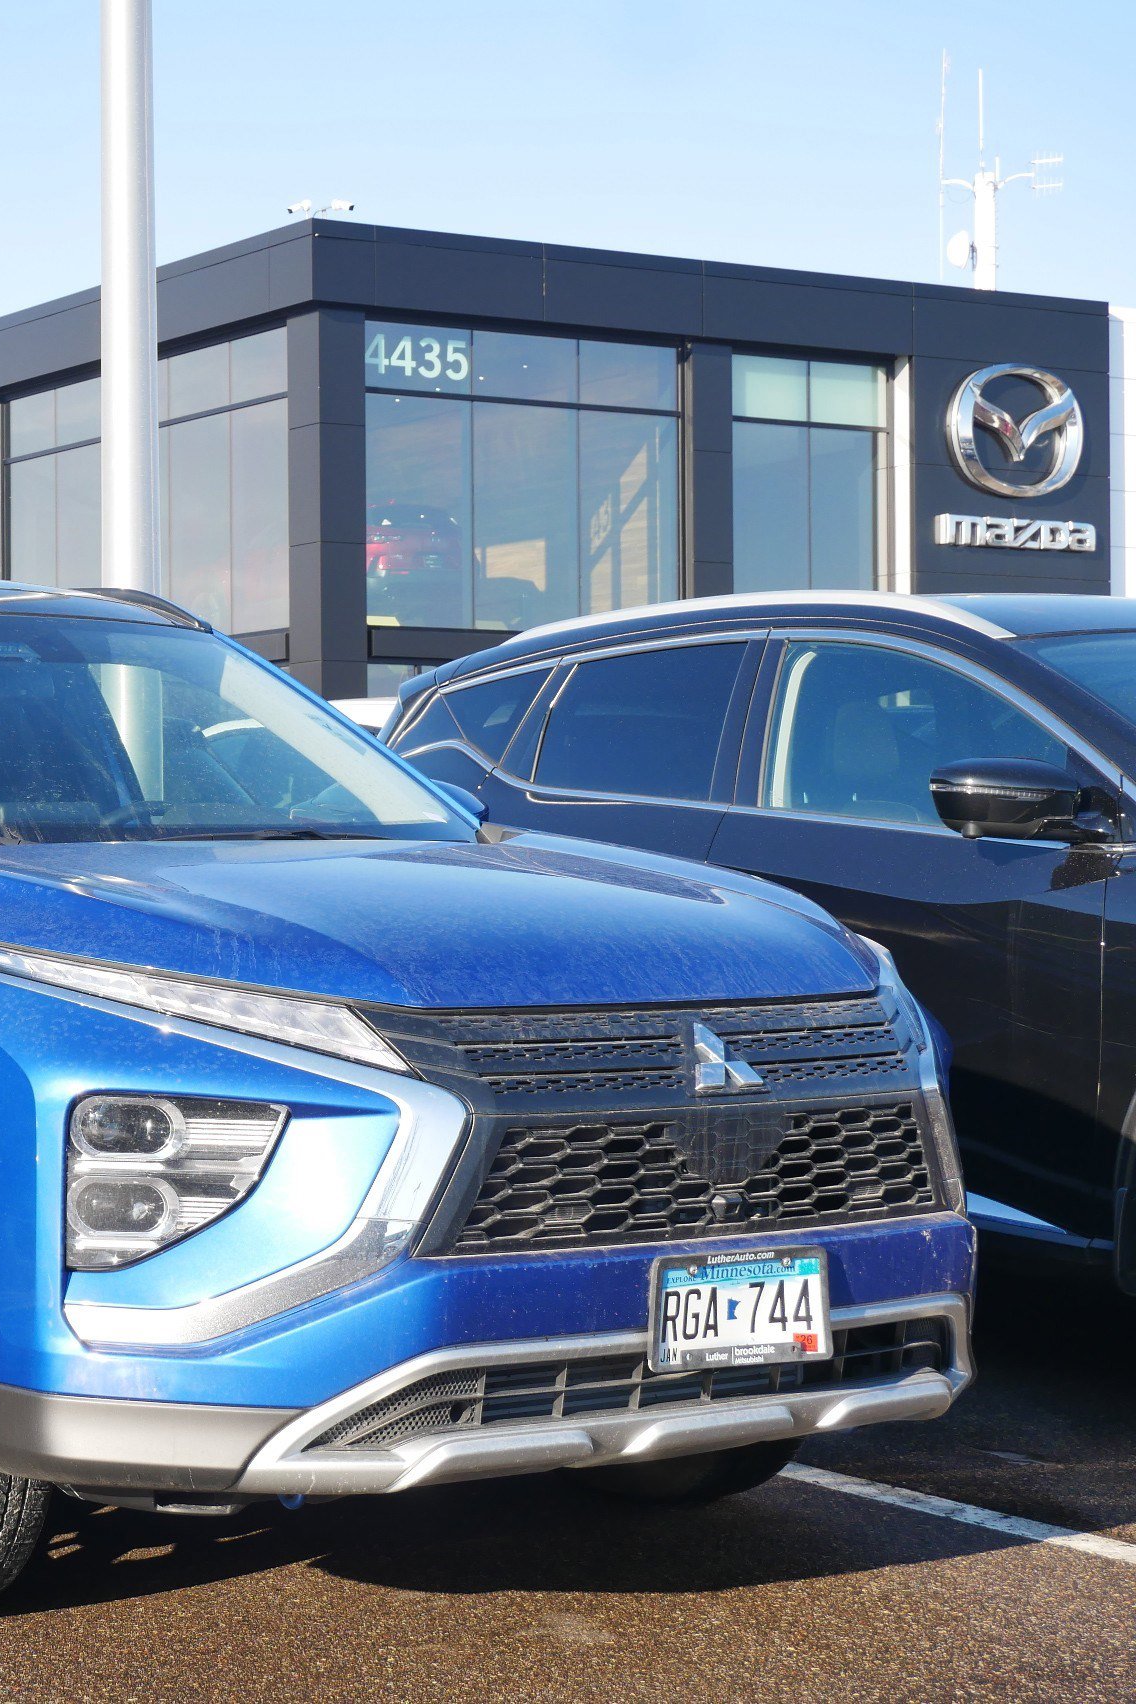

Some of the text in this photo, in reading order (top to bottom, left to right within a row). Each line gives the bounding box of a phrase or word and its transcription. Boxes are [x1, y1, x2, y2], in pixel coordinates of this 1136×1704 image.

[365, 333, 469, 381] 4435
[707, 1251, 775, 1264] LutherAuto.com
[661, 1278, 813, 1343] RGA 744
[660, 1347, 677, 1363] JAN
[705, 1352, 728, 1362] Luther
[734, 1345, 775, 1356] brookdale
